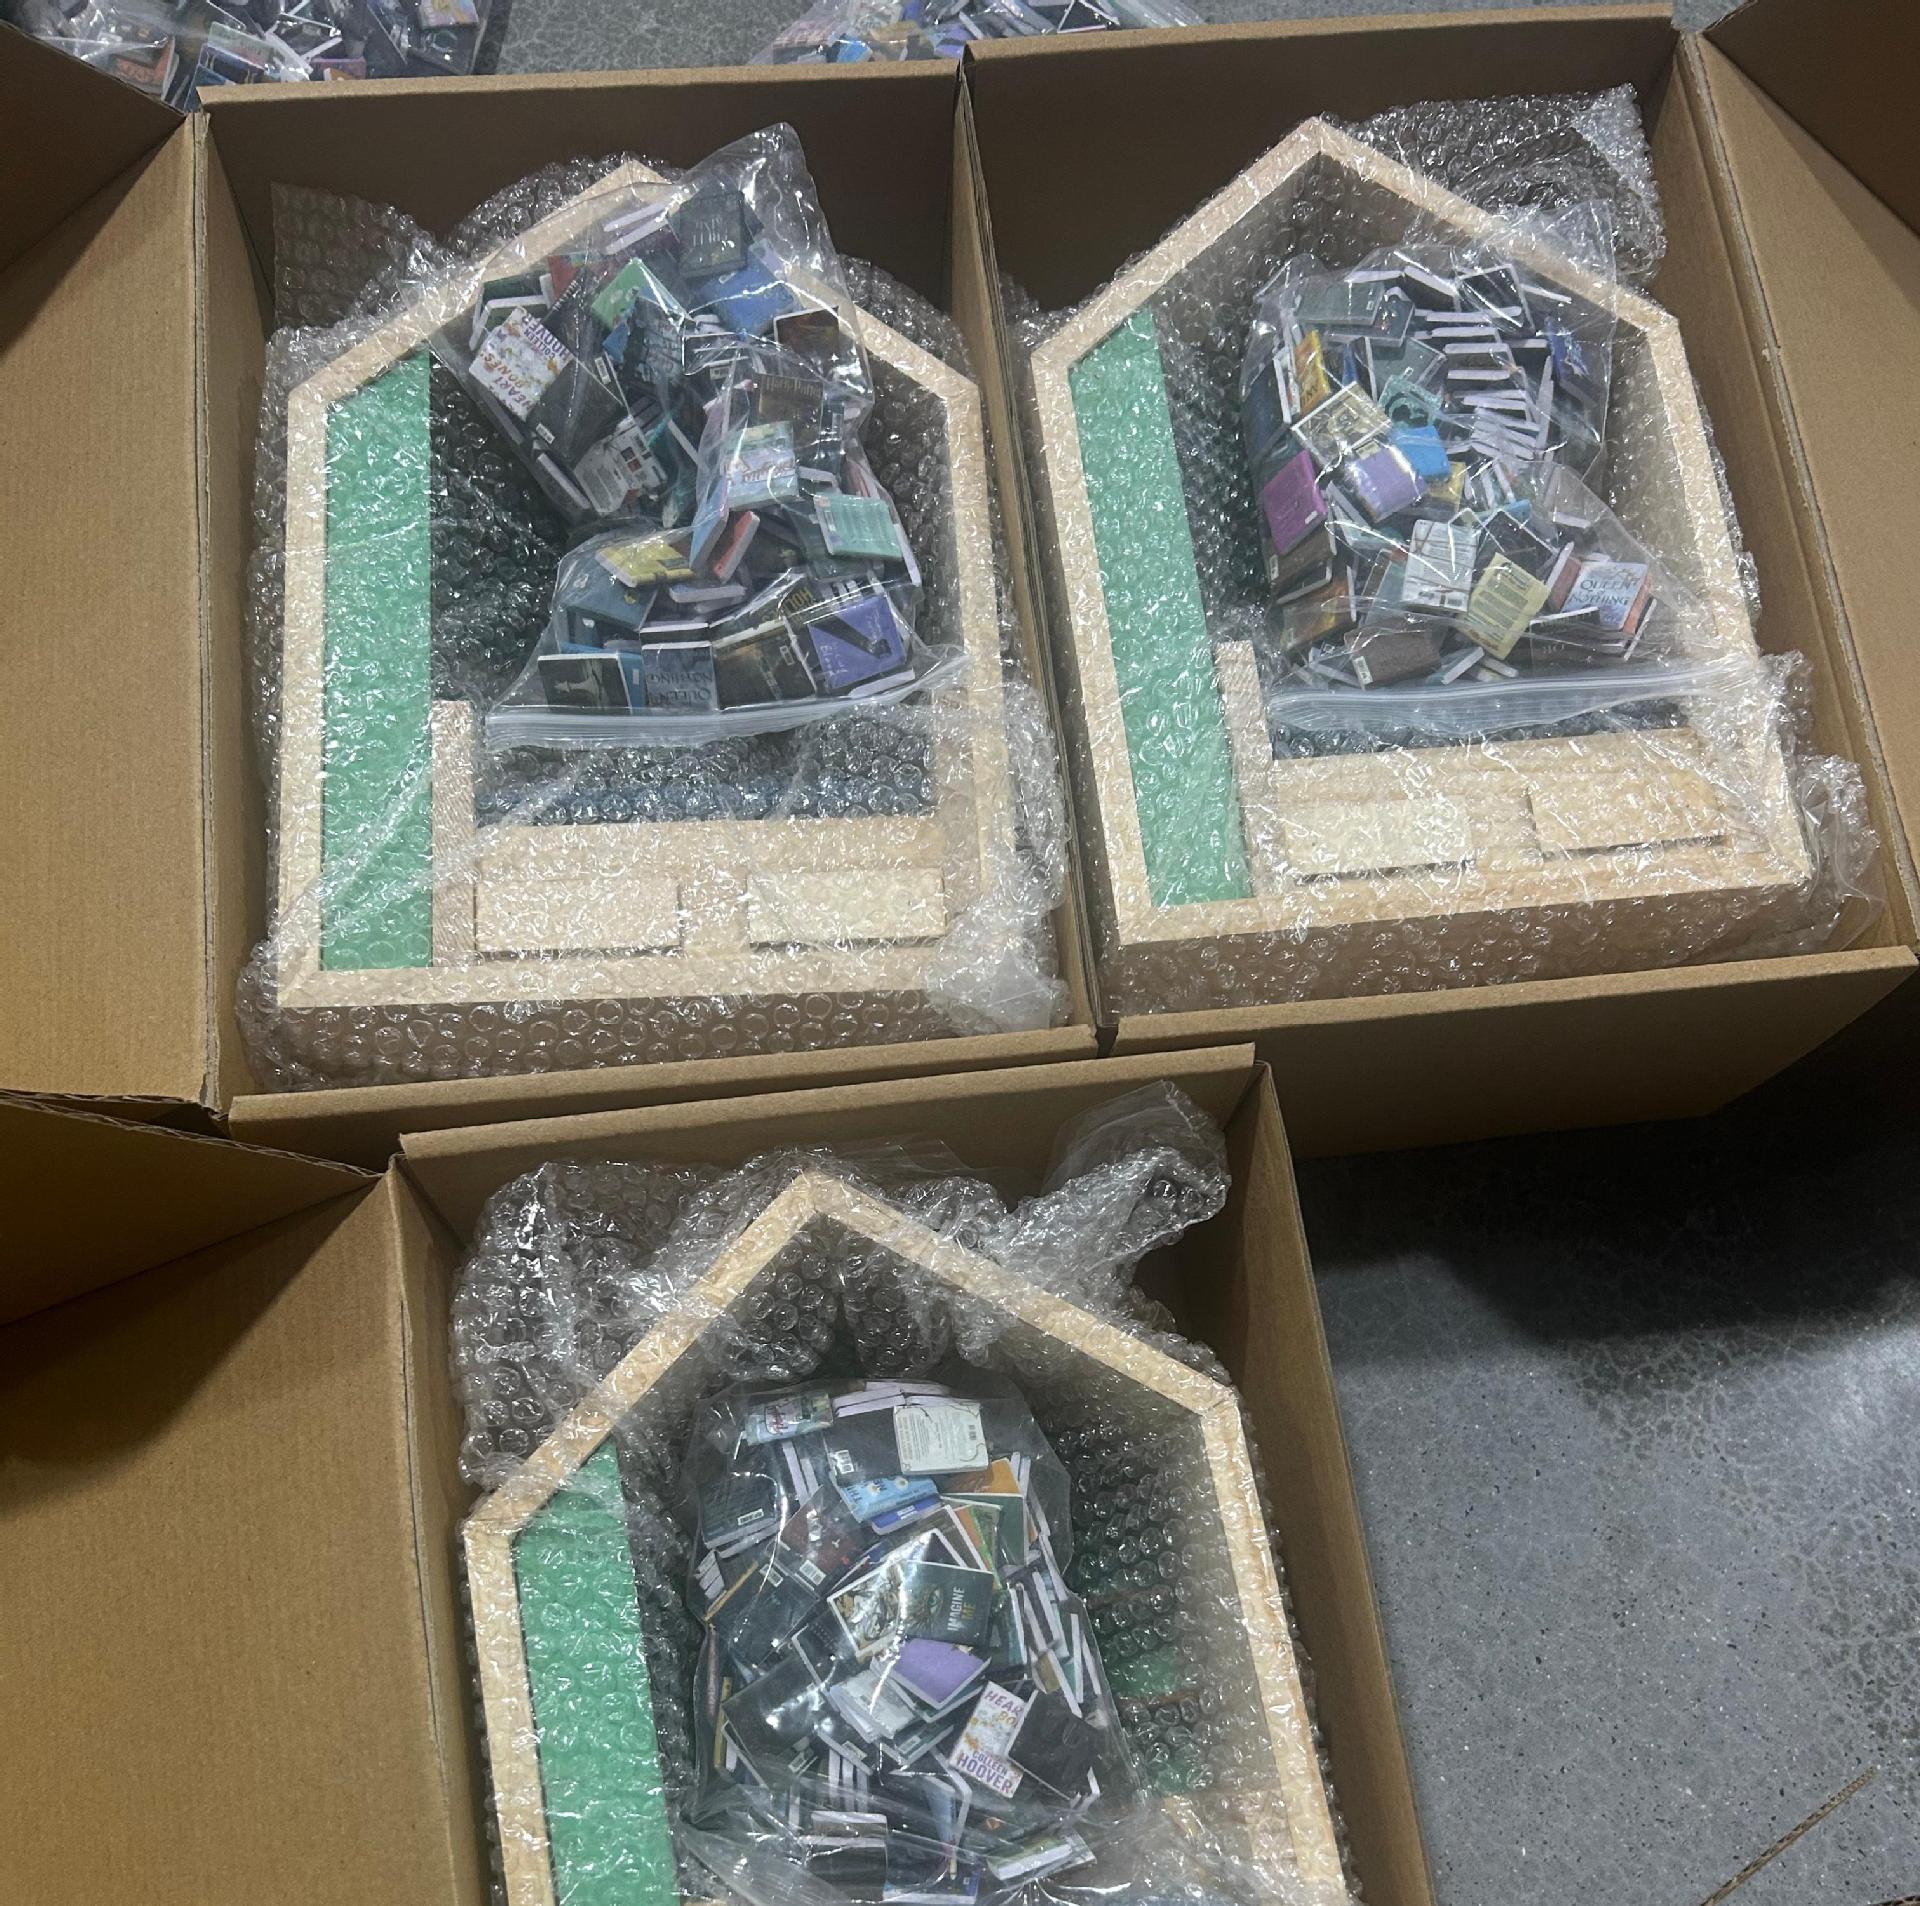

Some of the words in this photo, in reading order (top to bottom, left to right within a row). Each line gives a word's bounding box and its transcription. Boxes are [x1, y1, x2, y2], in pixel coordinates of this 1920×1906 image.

[520, 312, 571, 361] HOOVER
[523, 328, 556, 360] COLLEEN
[484, 351, 527, 389] BONES
[494, 376, 535, 411] HEART
[1568, 593, 1632, 606] NOTHING
[1579, 577, 1641, 592] QUEEN
[946, 1586, 965, 1632] IMAGINE
[961, 1601, 974, 1622] ME
[984, 1690, 1025, 1716] HEAR
[957, 1752, 1014, 1795] HOOVER
[973, 1750, 1008, 1776] COLLEEN
